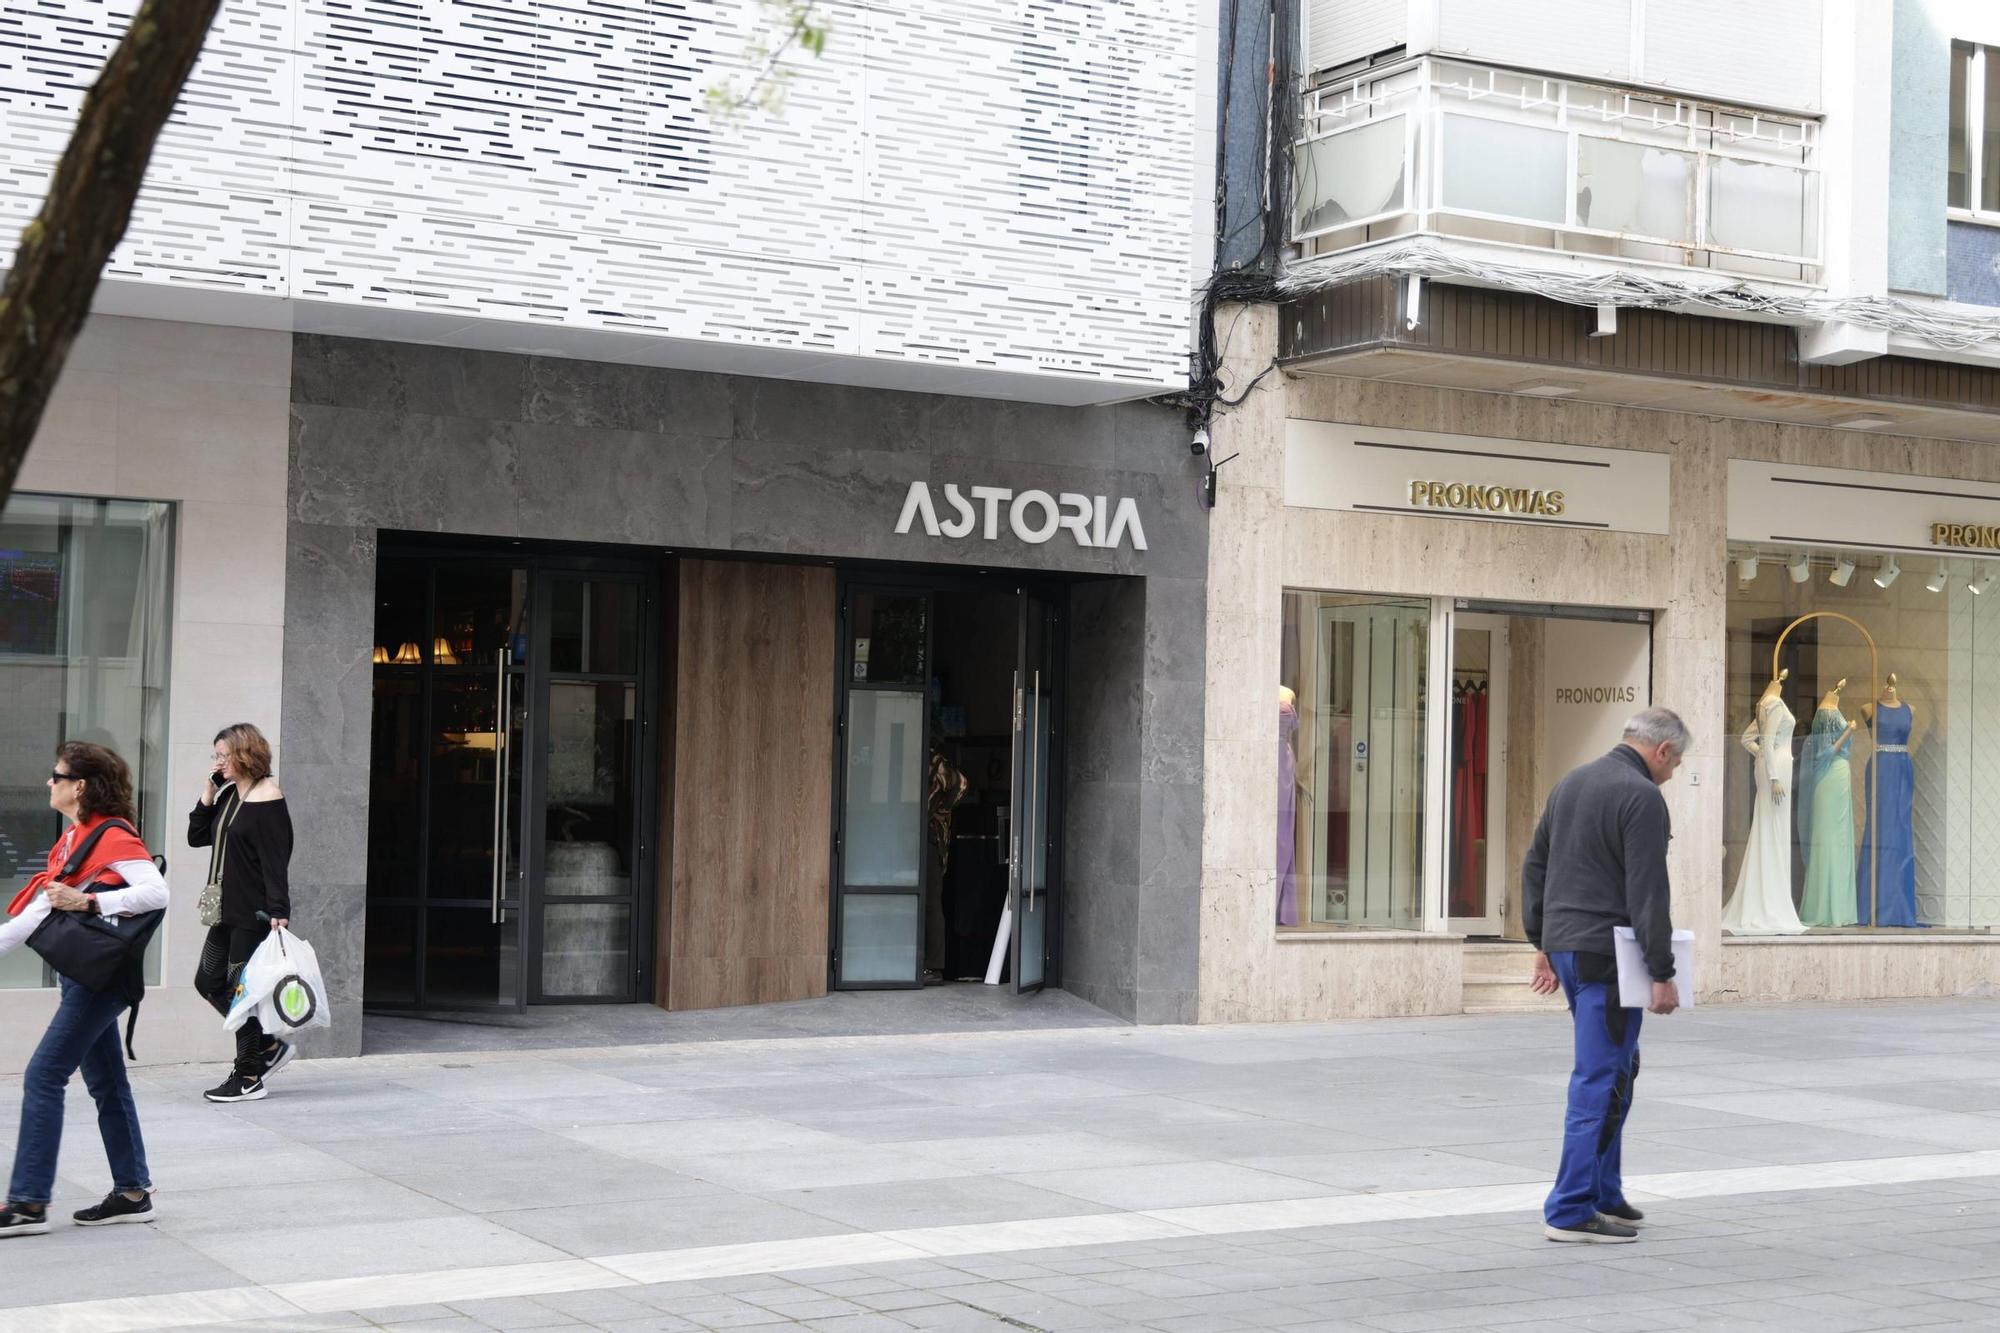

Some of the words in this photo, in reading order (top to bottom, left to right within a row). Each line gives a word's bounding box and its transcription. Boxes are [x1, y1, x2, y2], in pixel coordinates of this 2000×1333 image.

[894, 481, 1148, 550] ASTORIA
[1411, 481, 1565, 516] PRONOVIAS
[1556, 686, 1635, 704] PRONOVIAS
